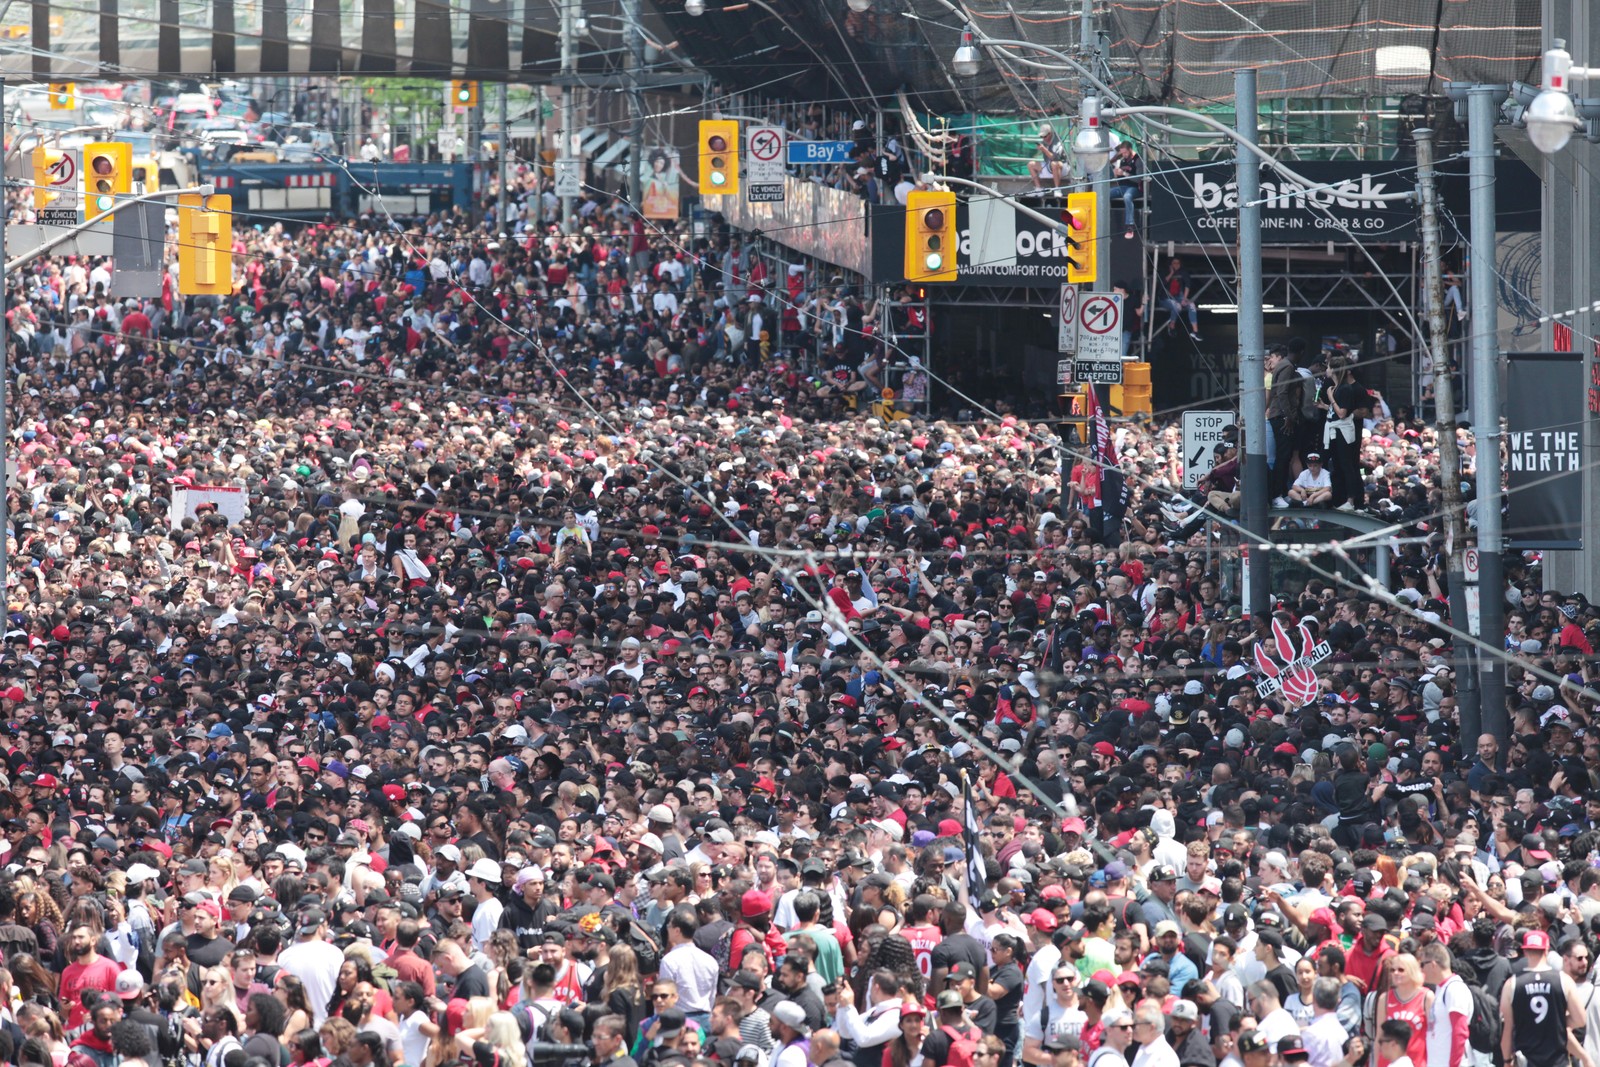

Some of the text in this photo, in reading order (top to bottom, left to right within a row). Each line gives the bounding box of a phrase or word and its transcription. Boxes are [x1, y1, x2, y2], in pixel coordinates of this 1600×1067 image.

[807, 144, 834, 161] Bay
[1197, 217, 1385, 229] COFFE INE-IN GRAB & GO
[957, 264, 1068, 277] NADIAN COMFORT FOOD
[1077, 363, 1120, 372] TTC VEHICLES
[1078, 372, 1118, 380] EXCEPTED
[1195, 417, 1223, 428] STOP
[1194, 431, 1223, 441] HERE
[1511, 431, 1579, 451] WE THE
[1511, 452, 1579, 472] NORTH
[1258, 680, 1276, 696] WE
[1274, 668, 1295, 686] THE
[1525, 982, 1551, 995] IBAKA
[1529, 995, 1549, 1024] 9
